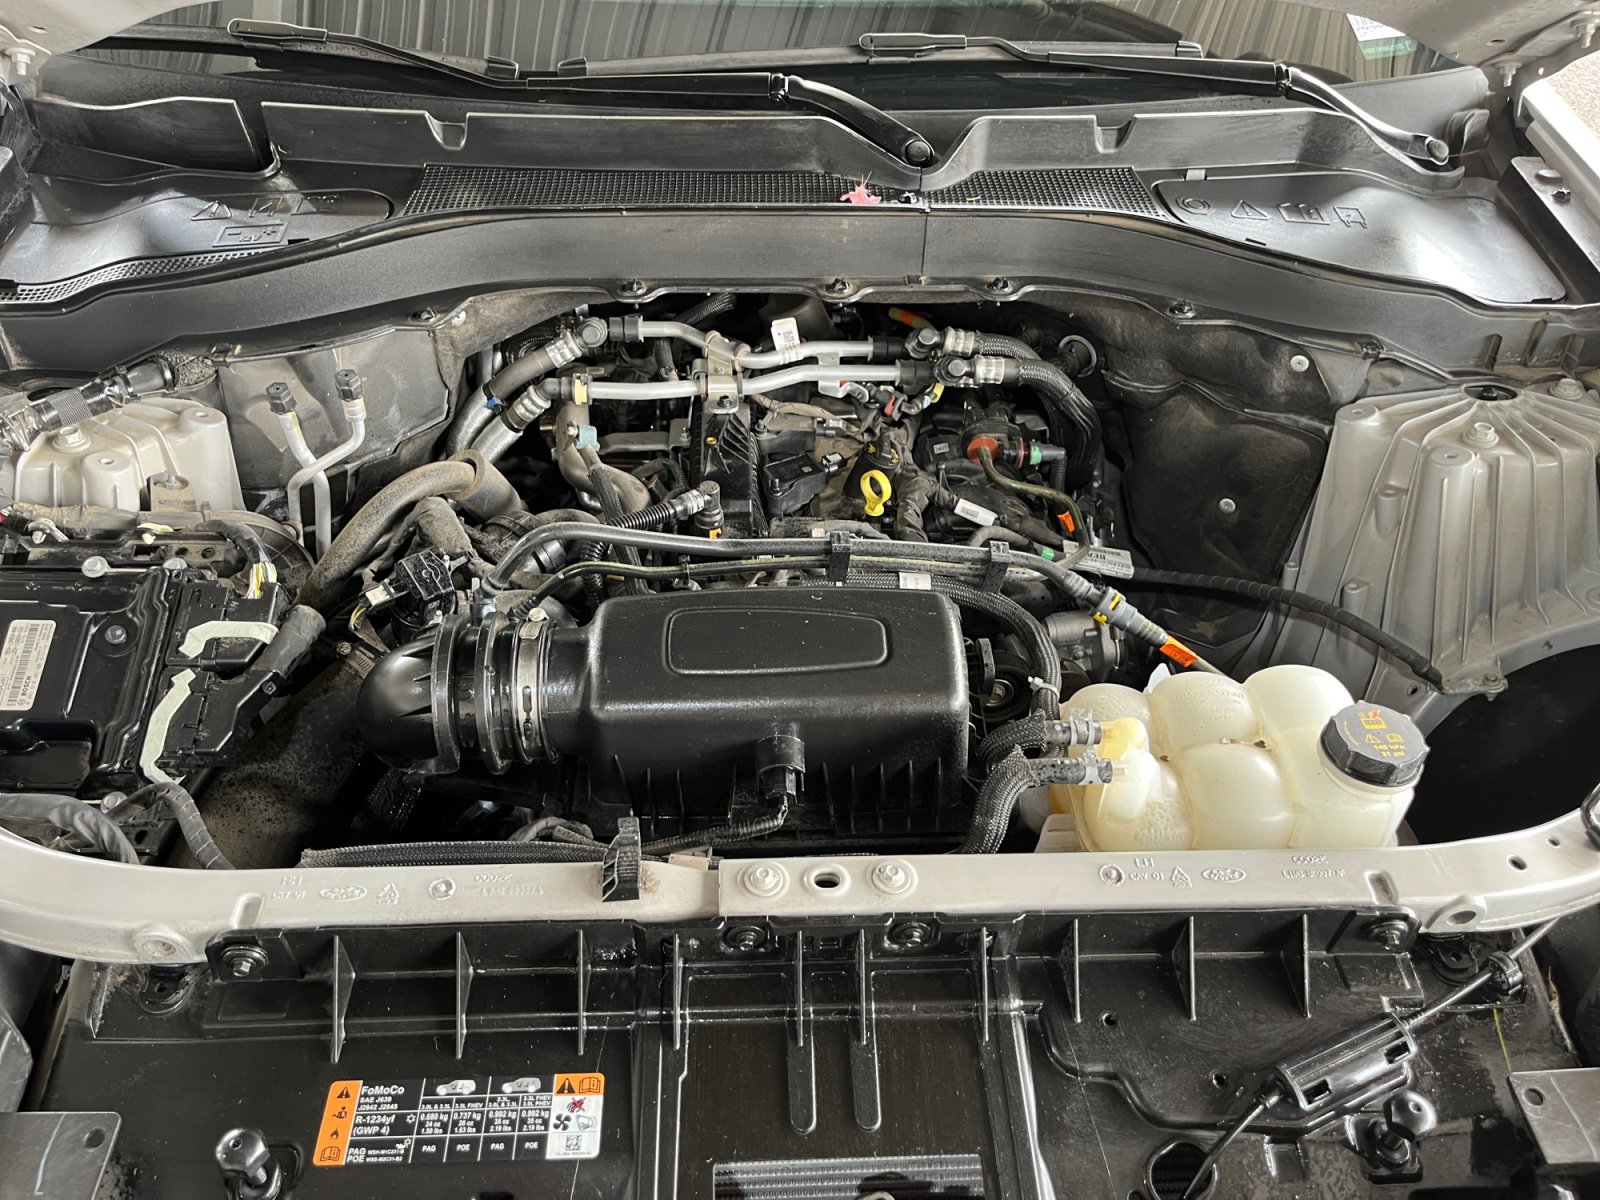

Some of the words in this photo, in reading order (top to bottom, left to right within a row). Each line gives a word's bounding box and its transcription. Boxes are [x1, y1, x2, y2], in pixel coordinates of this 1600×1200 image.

[21, 675, 32, 697] BOSCH
[361, 1085, 405, 1095] FoMoCo
[420, 1113, 439, 1121] 0.680
[440, 1113, 449, 1122] kg
[453, 1112, 472, 1120] 0.737
[473, 1112, 481, 1121] kg
[488, 1110, 507, 1118] 0.992
[508, 1110, 517, 1119] kg
[521, 1109, 540, 1117] 0.992
[541, 1110, 550, 1118] kg
[355, 1115, 396, 1125] R-1234yf
[352, 1127, 379, 1136] (GWP
[380, 1126, 390, 1135] 4)
